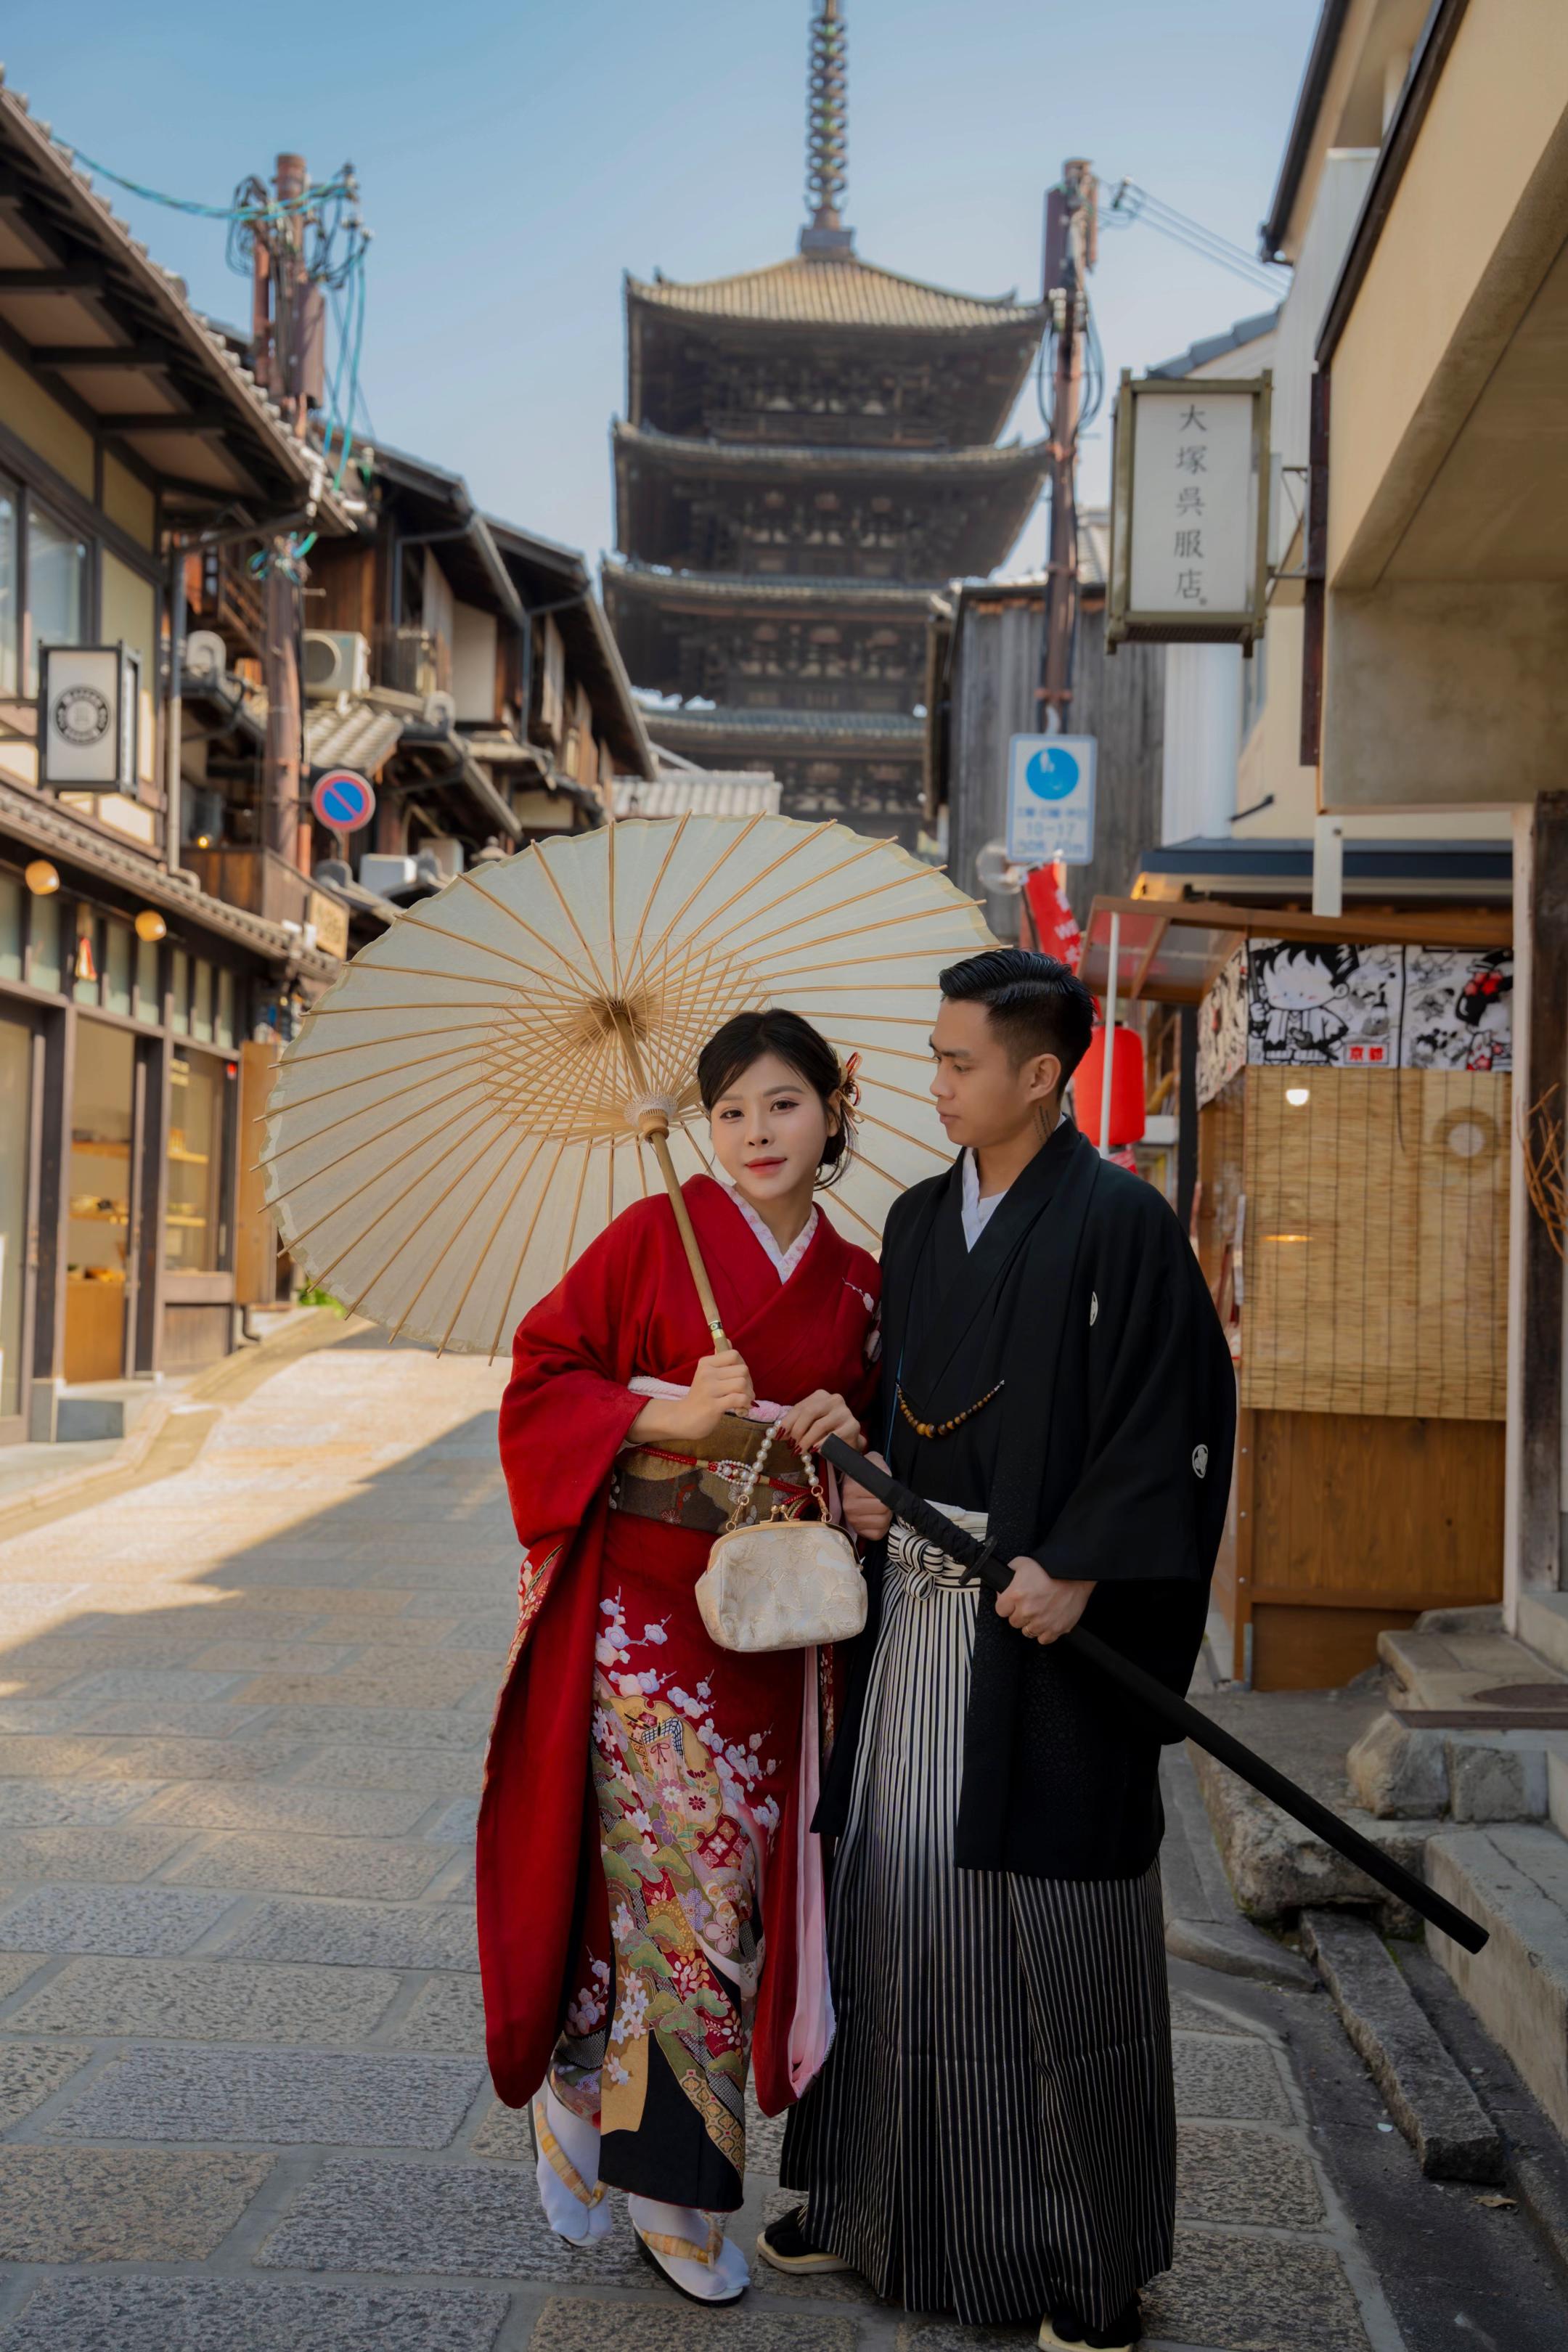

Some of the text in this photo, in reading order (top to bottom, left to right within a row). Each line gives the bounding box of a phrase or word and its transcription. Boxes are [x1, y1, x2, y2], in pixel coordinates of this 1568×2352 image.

[1174, 404, 1207, 600] 大塚呉服店
[1349, 1046, 1384, 1061] 京都
